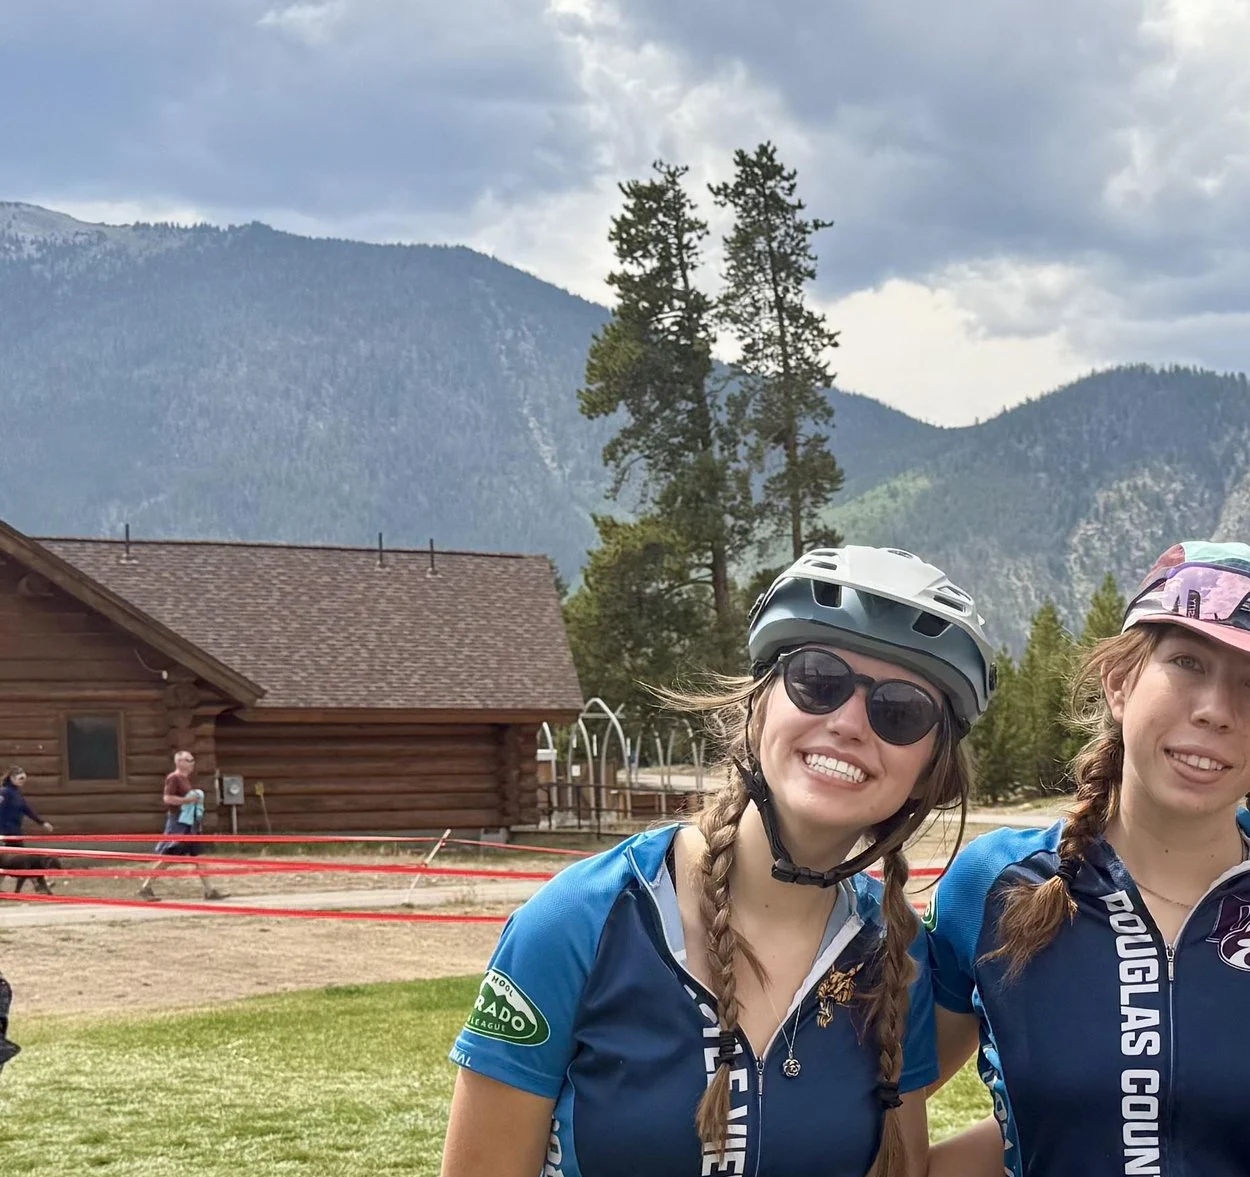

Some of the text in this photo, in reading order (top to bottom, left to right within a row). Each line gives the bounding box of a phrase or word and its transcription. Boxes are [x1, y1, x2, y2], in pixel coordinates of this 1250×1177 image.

[491, 975, 513, 998] HOOL
[1100, 890, 1160, 1057] DOUGLAS
[474, 994, 526, 1031] RADO
